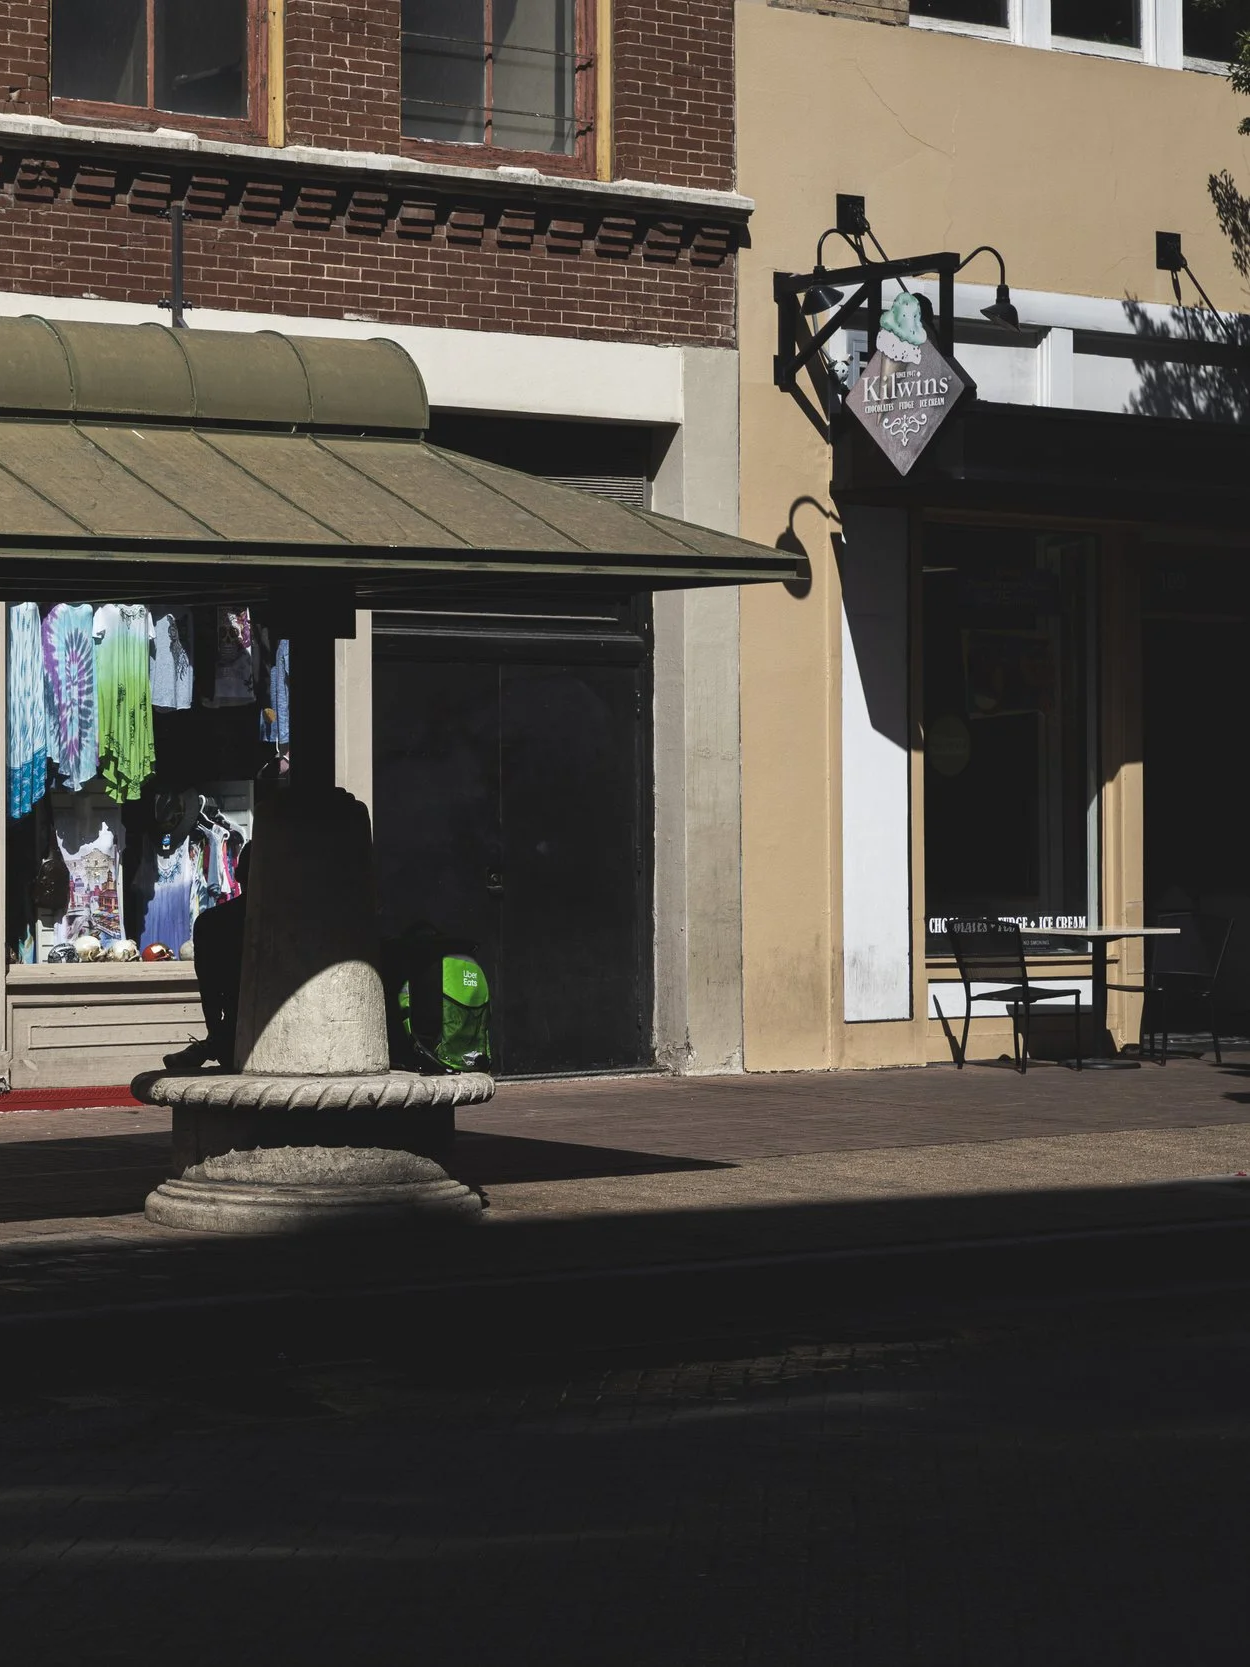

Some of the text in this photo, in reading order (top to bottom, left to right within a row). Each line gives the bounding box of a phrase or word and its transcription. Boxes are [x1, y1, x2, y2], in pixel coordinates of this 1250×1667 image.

[861, 372, 949, 403] Kilwins
[864, 397, 945, 414] CHOCOLATES FUDGE ICE CREAM
[929, 916, 988, 934] CHOOLATES
[1038, 916, 1053, 930] ICE
[1055, 915, 1087, 930] CREAM
[463, 970, 478, 979] Uber
[463, 977, 478, 987] Eats
